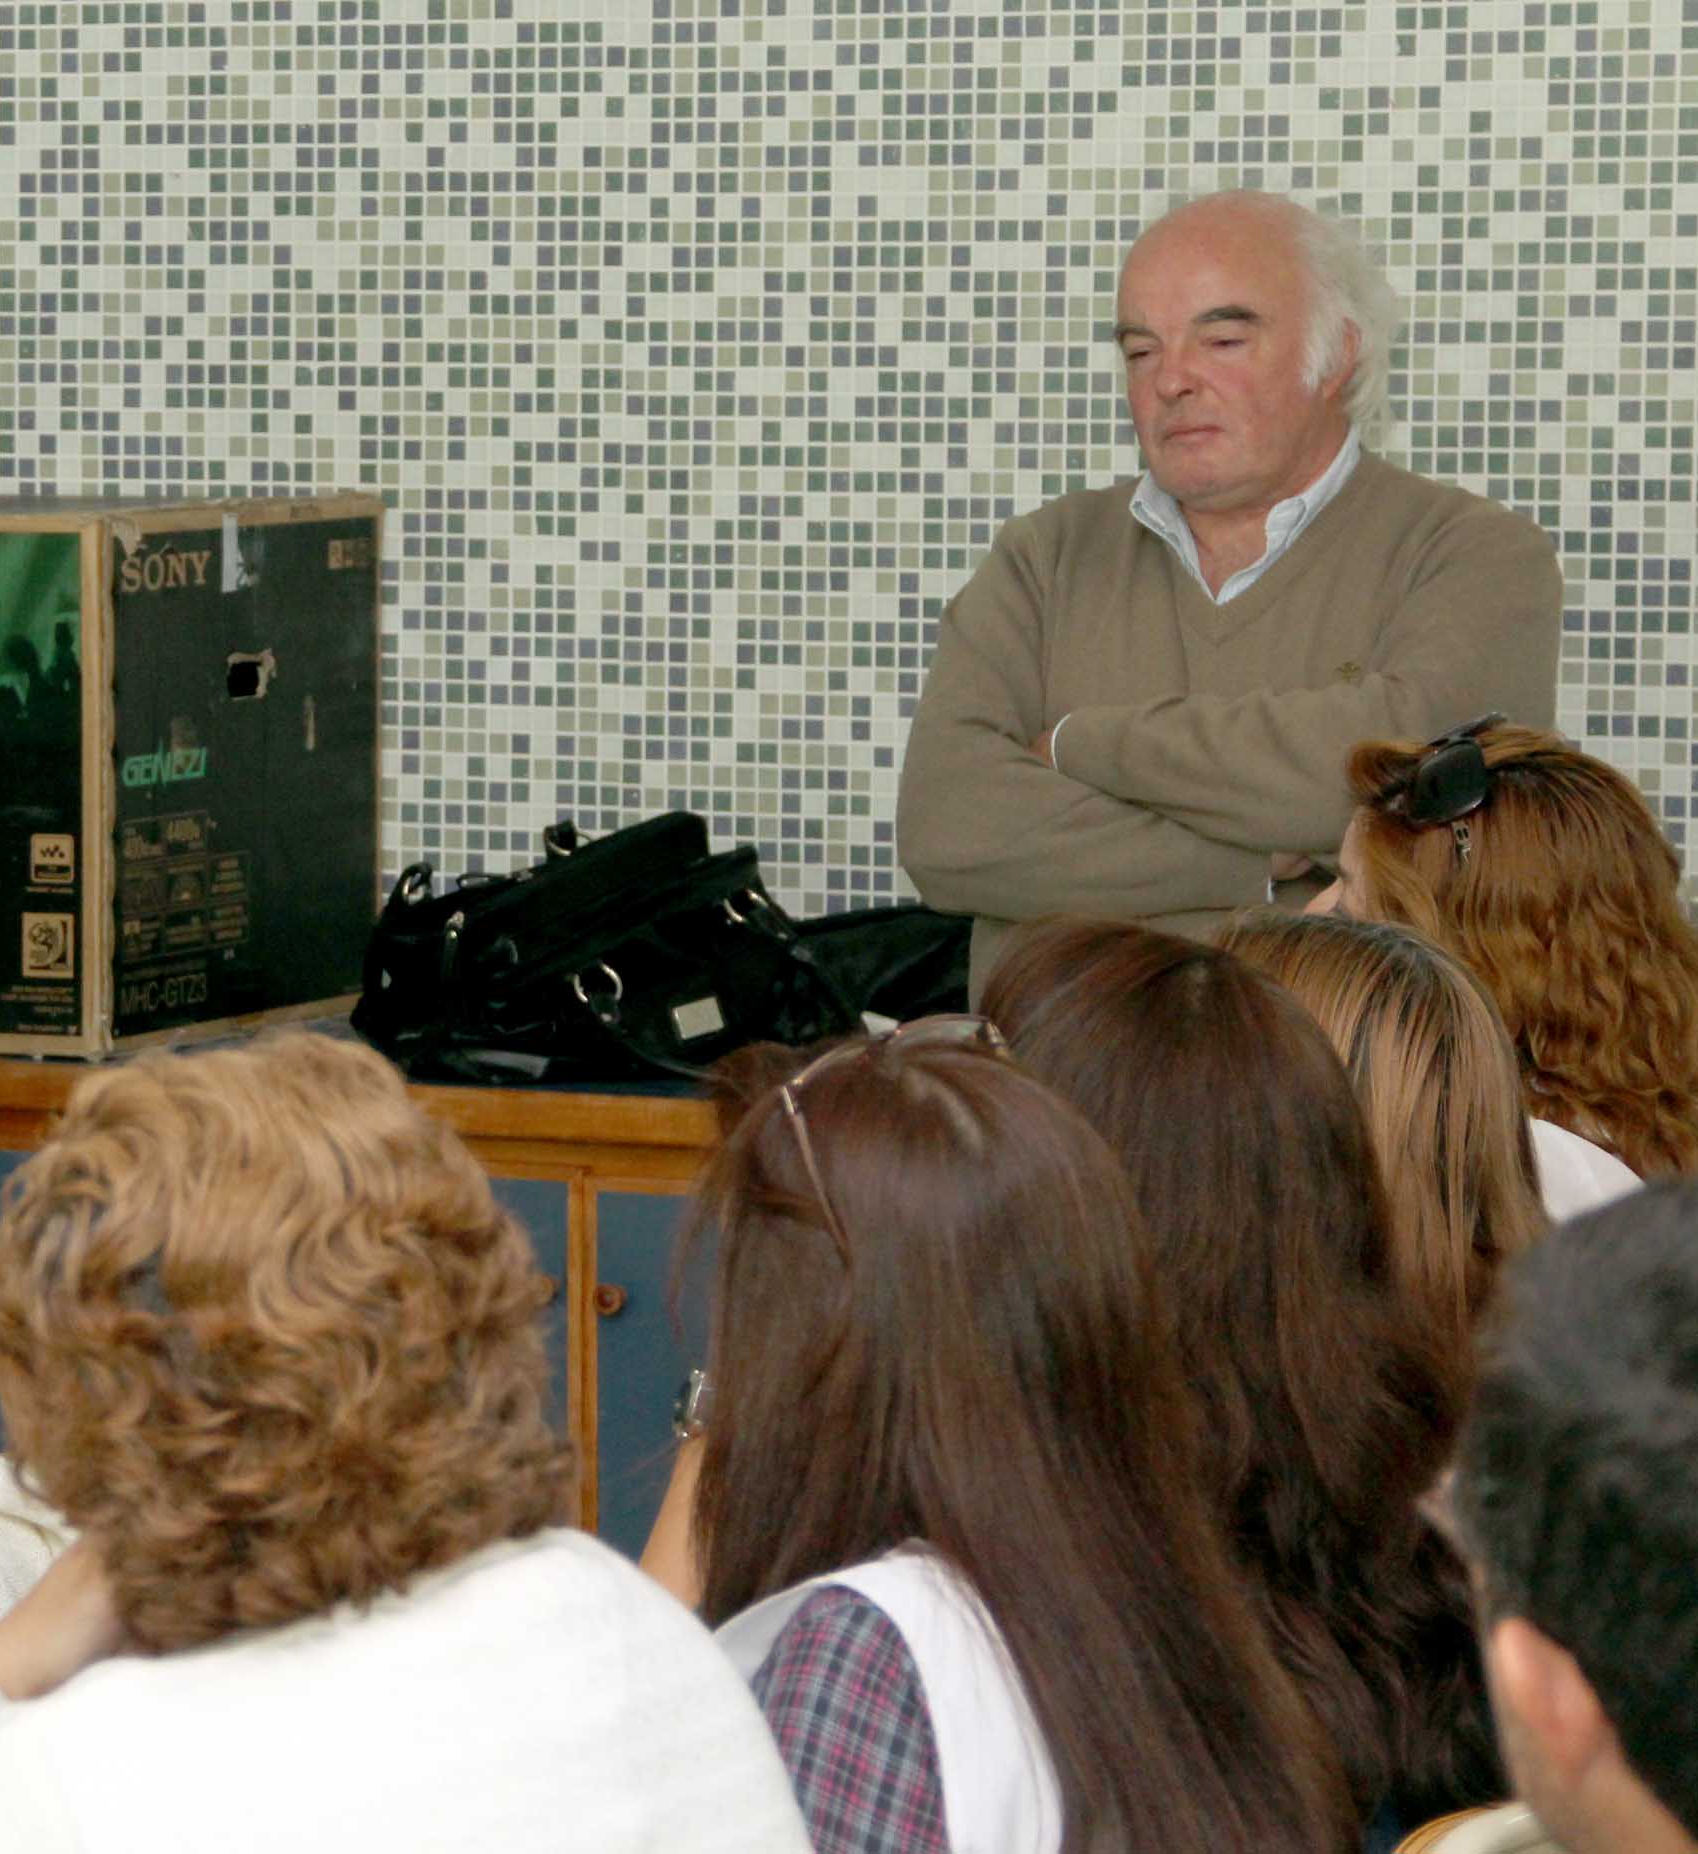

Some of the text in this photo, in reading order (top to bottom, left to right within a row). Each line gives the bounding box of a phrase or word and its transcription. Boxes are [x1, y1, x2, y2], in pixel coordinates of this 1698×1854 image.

[121, 551, 211, 592] SONY
[122, 738, 207, 788] GENEZI
[119, 973, 207, 1016] MHC-GTZ3
